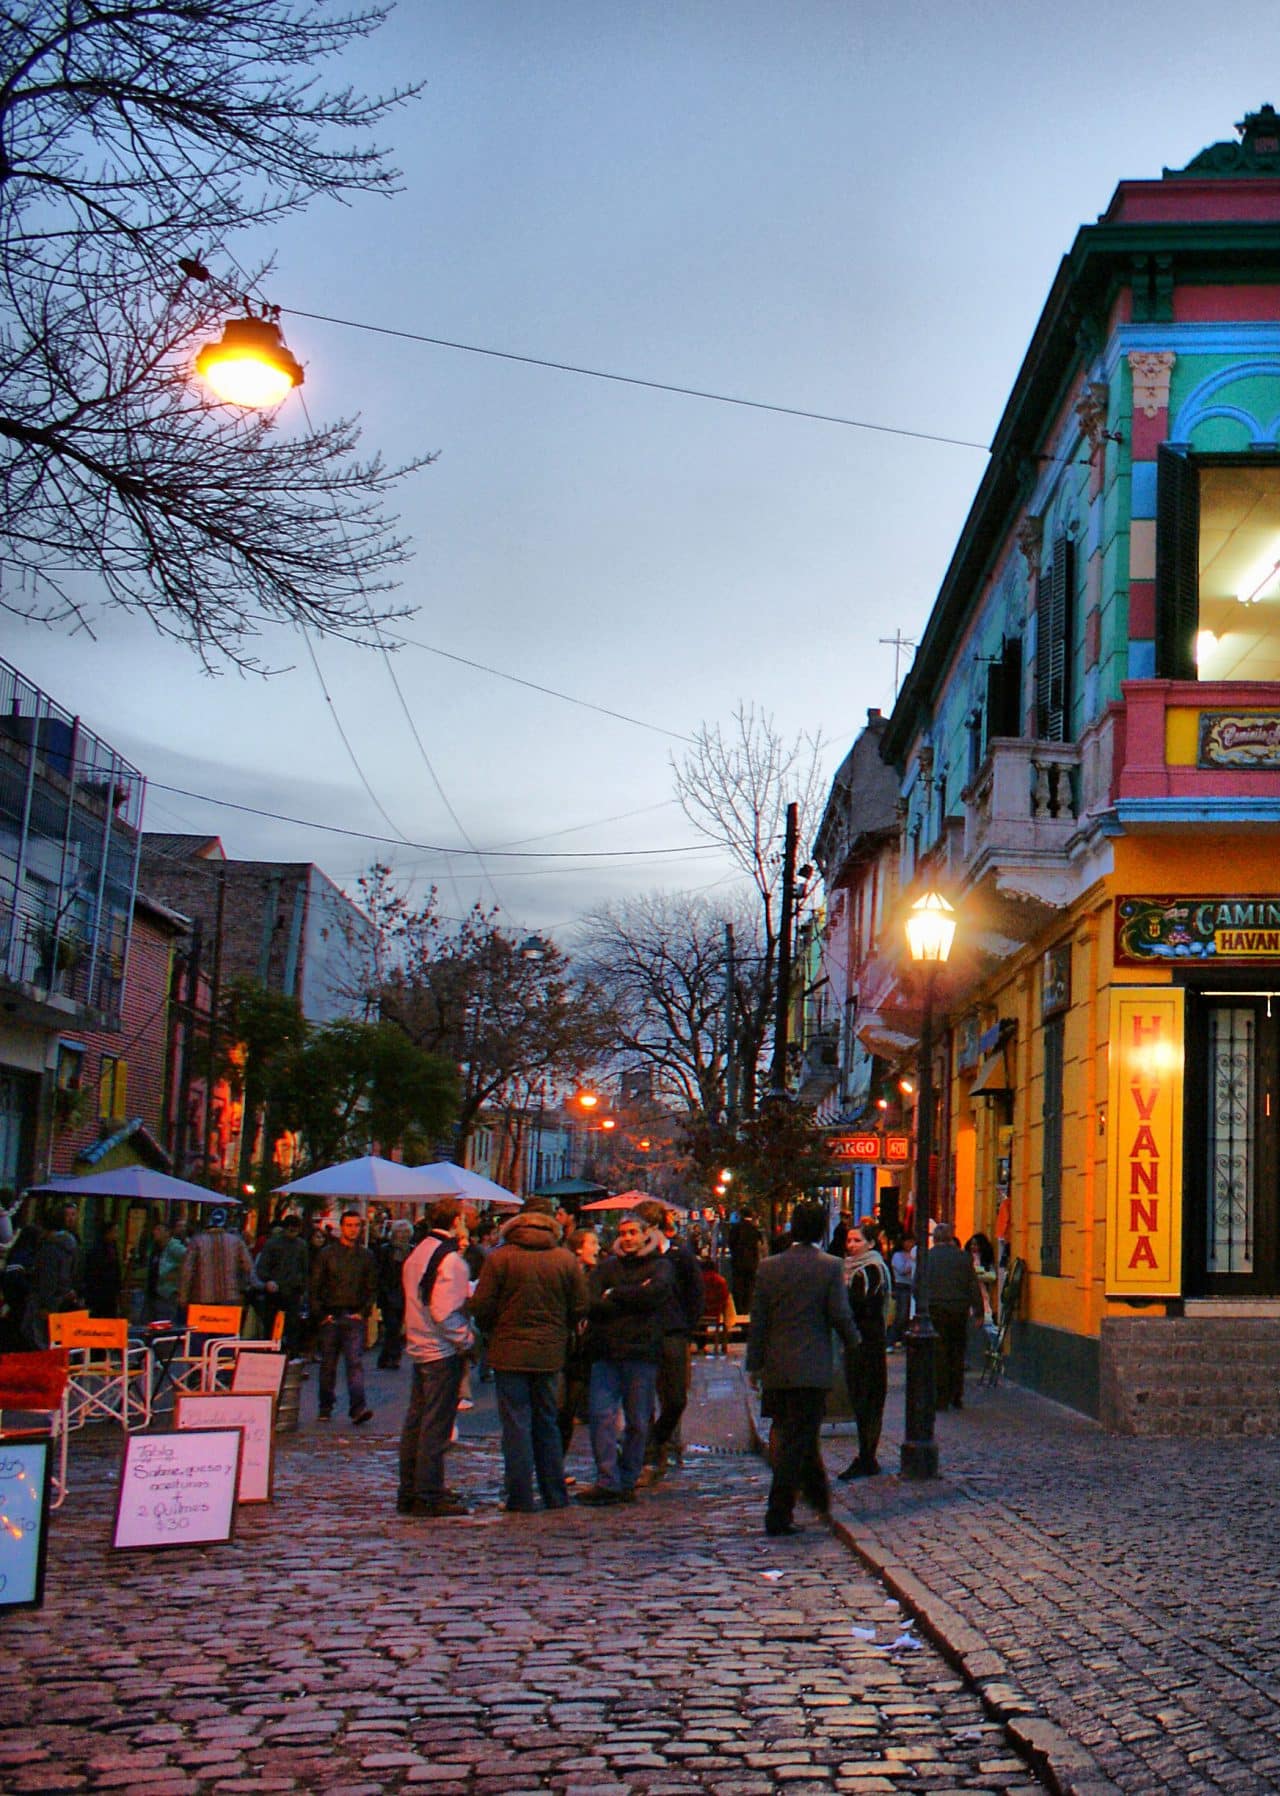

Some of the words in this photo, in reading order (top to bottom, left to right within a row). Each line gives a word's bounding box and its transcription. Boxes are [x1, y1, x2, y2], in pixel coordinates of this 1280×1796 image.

[1128, 1016, 1161, 1269] HVANNA
[224, 1464, 232, 1476] y
[137, 1505, 148, 1517] 2
[153, 1501, 210, 1518] Quilmes
